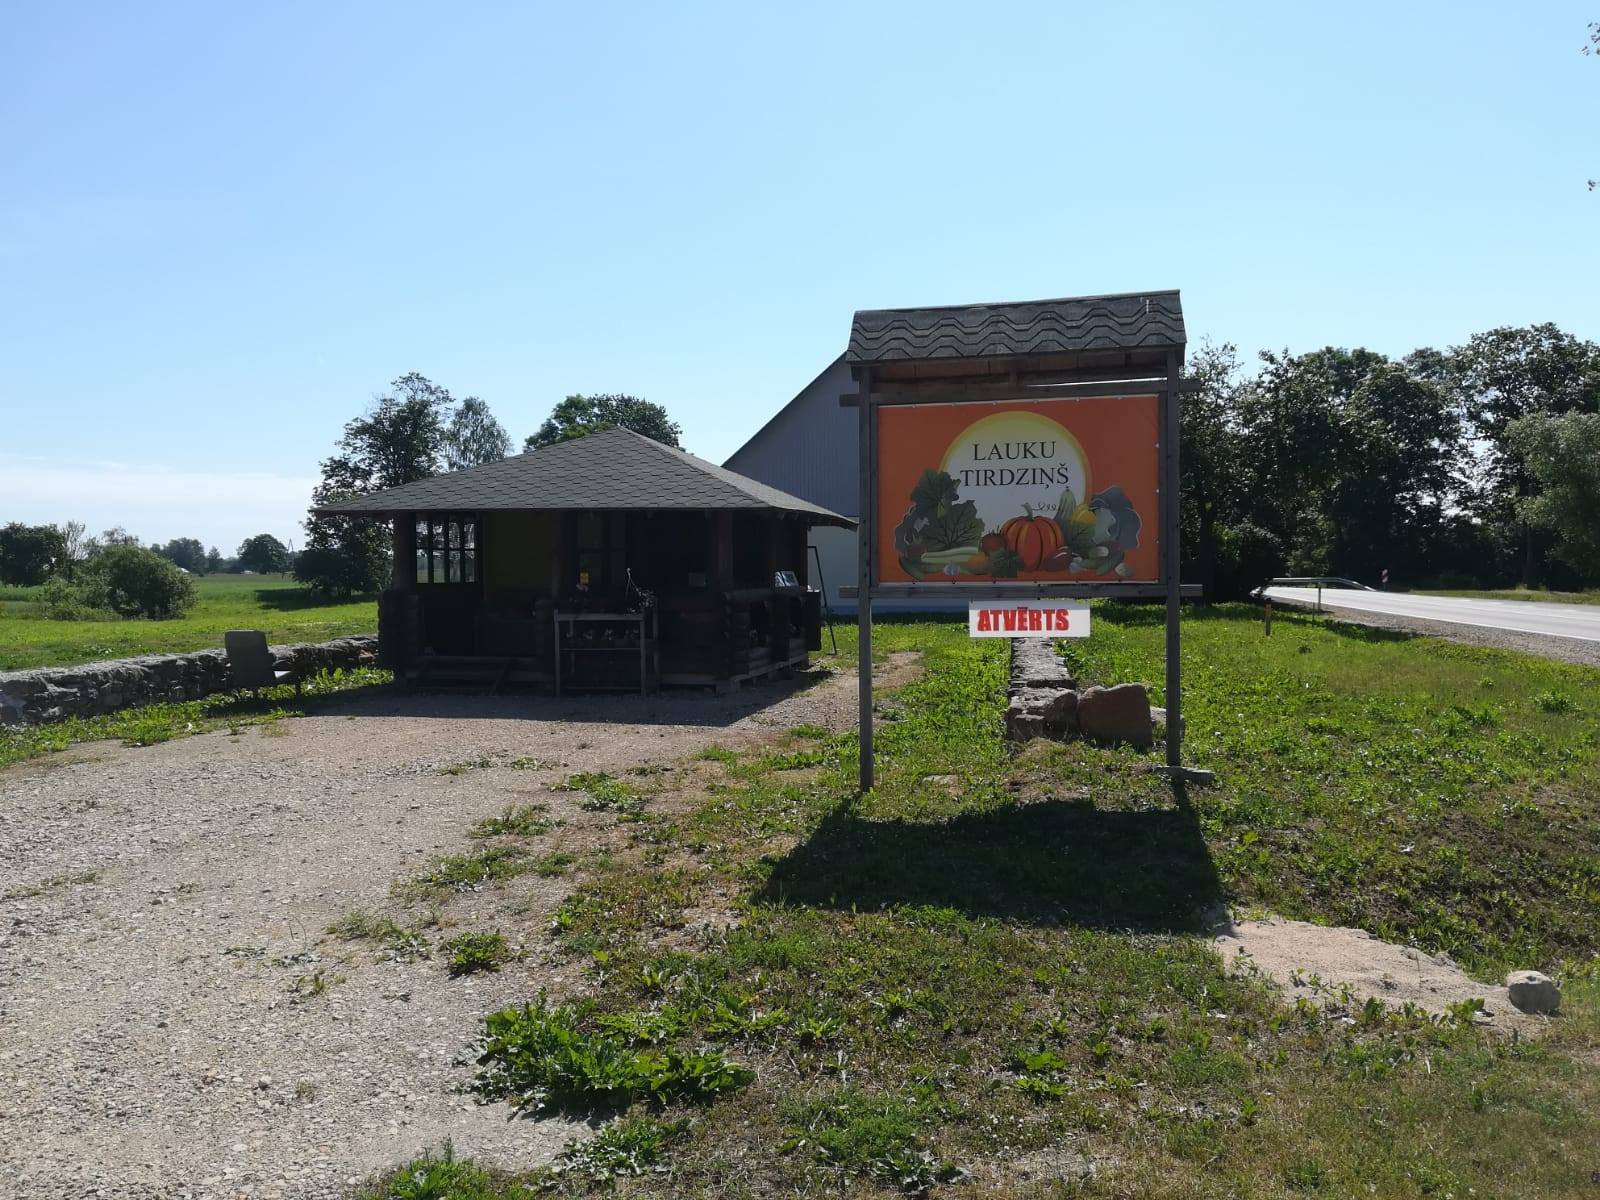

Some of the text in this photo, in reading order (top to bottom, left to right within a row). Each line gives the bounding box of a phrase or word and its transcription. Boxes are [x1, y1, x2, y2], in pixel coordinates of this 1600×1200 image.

[973, 441, 1056, 461] LAUKU
[960, 463, 1069, 489] TIRDZIŅŠ
[977, 607, 1070, 632] ATVĒRTS
